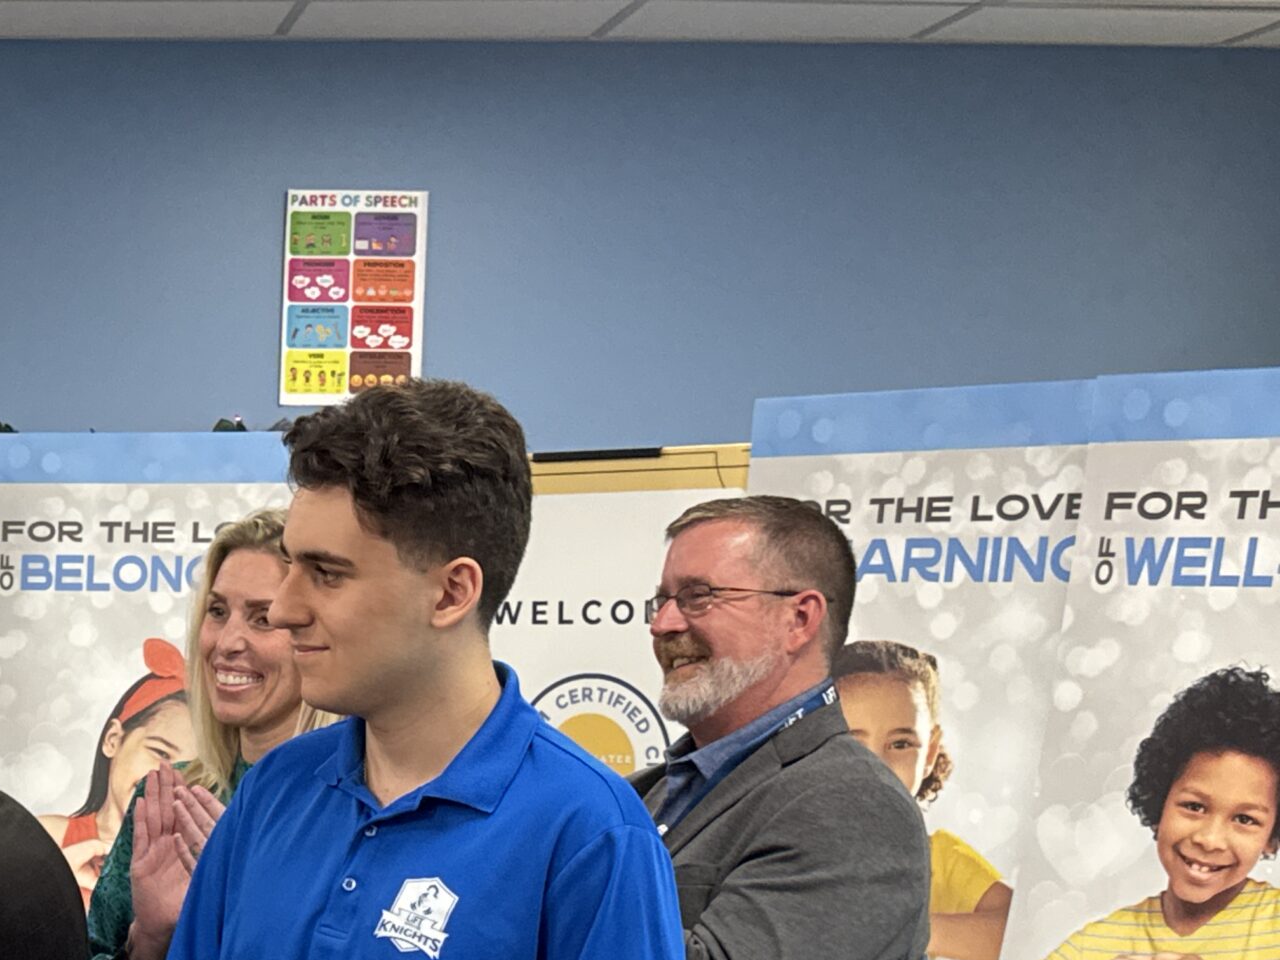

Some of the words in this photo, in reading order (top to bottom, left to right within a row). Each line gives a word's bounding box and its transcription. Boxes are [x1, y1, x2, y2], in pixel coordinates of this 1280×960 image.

[290, 194, 337, 207] PARTS
[341, 194, 360, 207] OF
[364, 195, 418, 208] SPEECH
[869, 496, 954, 524] THE
[970, 492, 1082, 522] LOVE
[1104, 491, 1208, 520] FOR
[1229, 490, 1280, 519] TH
[1, 520, 84, 543] FOR
[99, 521, 176, 543] THE
[0, 554, 15, 591] OF
[856, 535, 1077, 583] ARNIN
[1095, 536, 1116, 585] OF
[1125, 537, 1277, 587] WELL
[495, 599, 651, 625] WELCO
[555, 687, 650, 734] CERTIFIED
[378, 919, 441, 952] KNIGHTS
